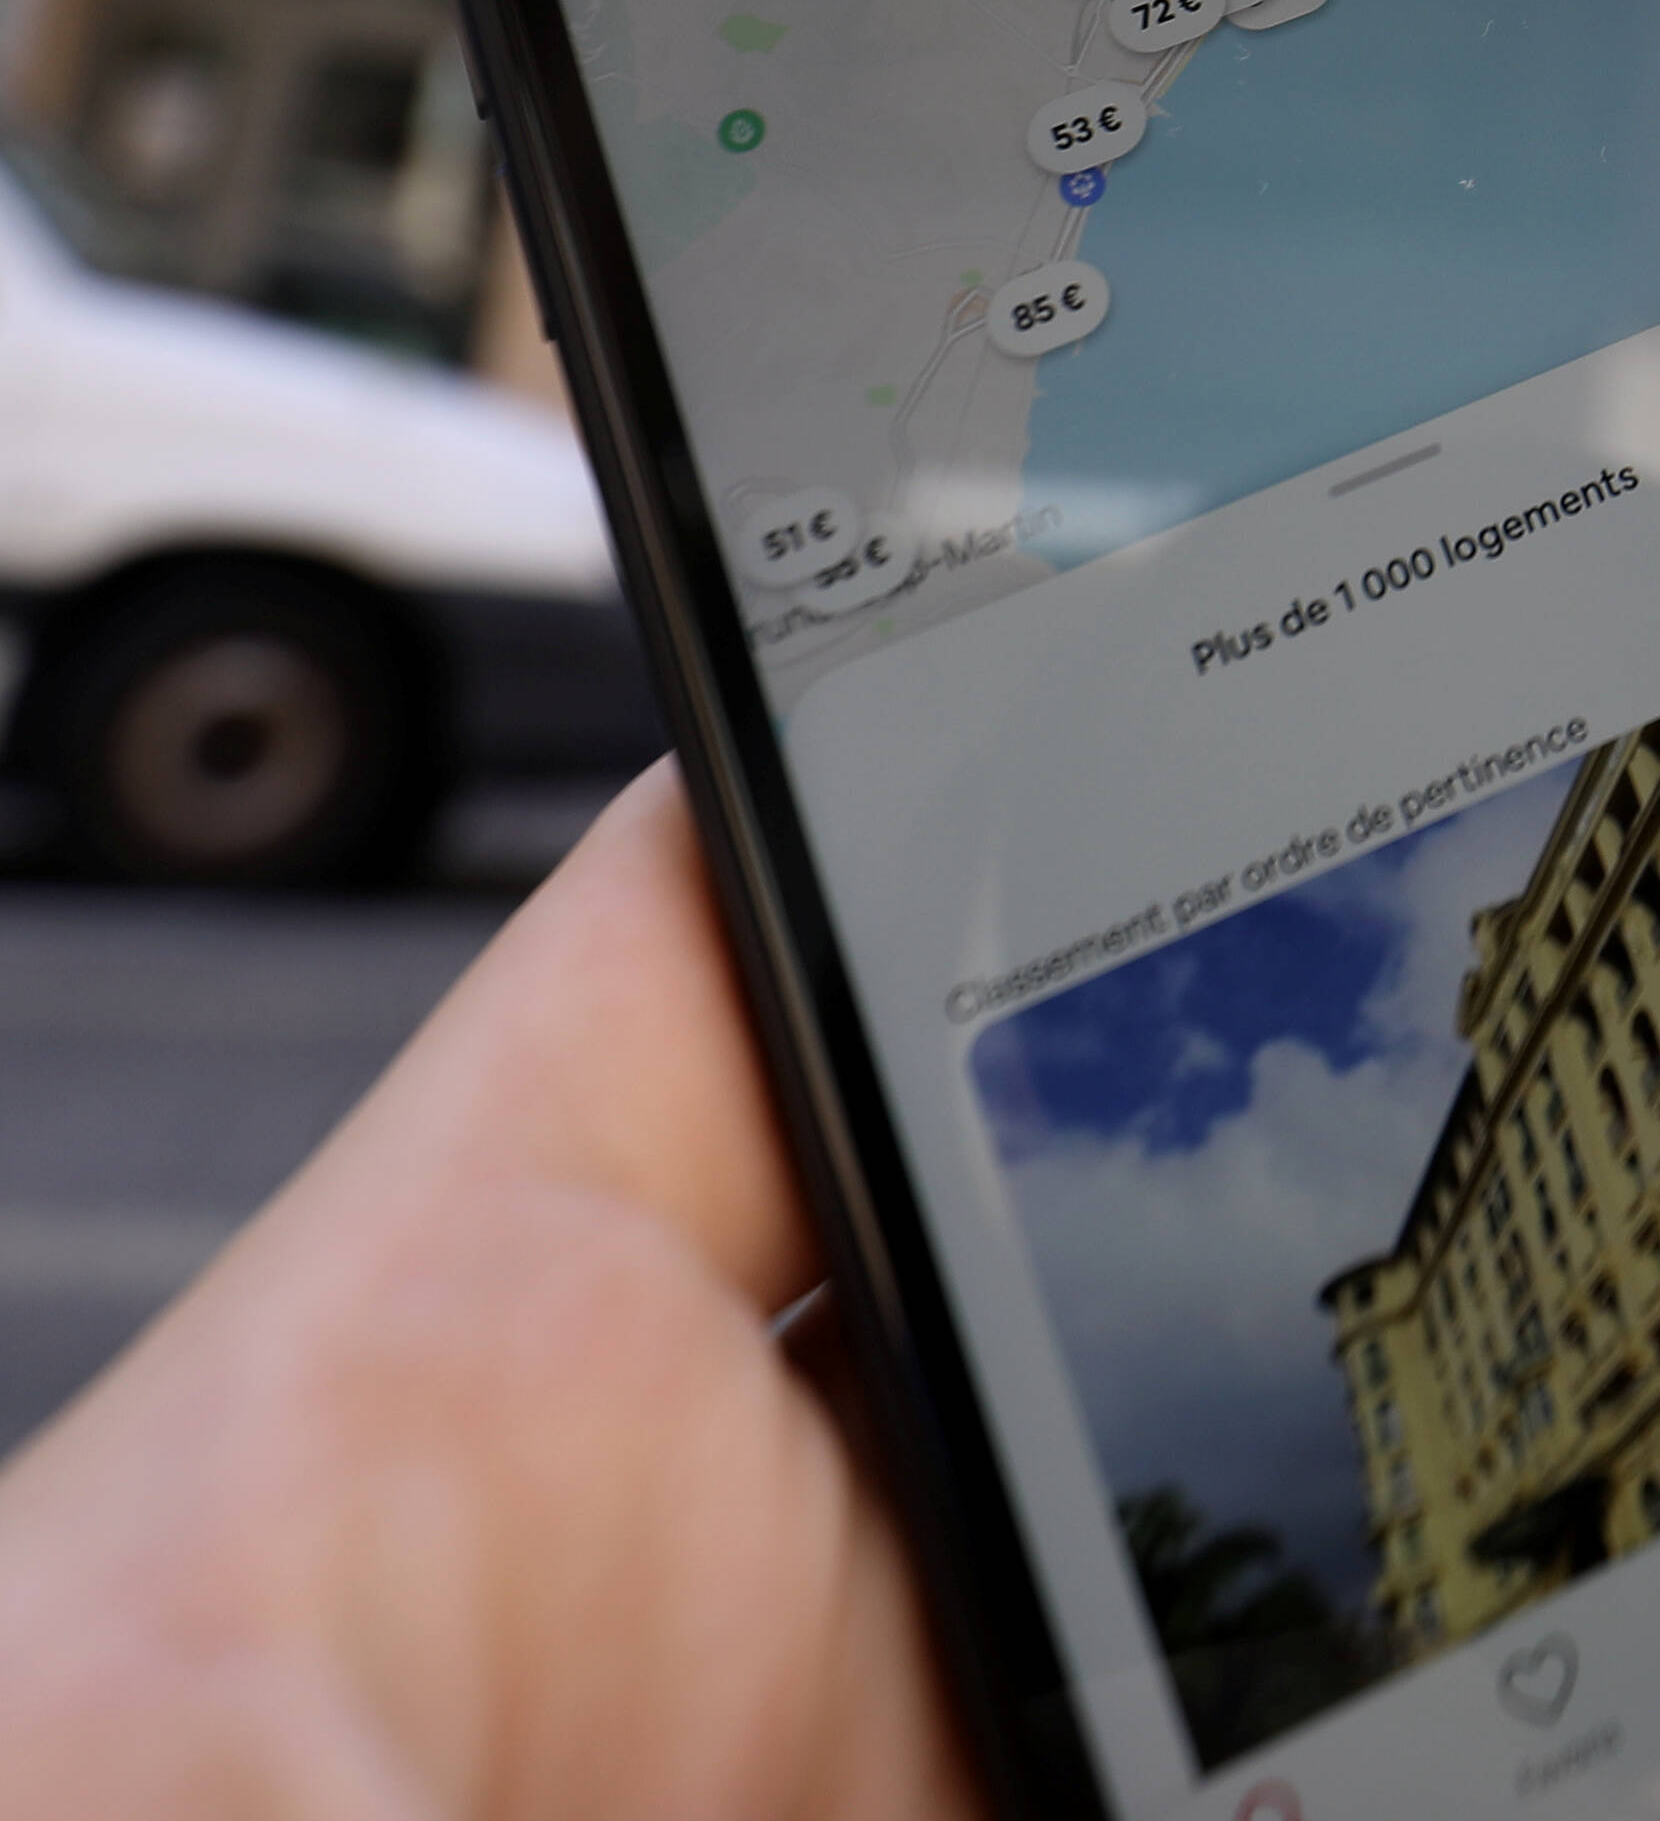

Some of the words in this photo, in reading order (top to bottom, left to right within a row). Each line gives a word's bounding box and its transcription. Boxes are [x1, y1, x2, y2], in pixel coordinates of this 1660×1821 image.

[1190, 620, 1274, 676] Plus
[1279, 596, 1331, 638] de
[1439, 464, 1640, 568] logements
[1172, 872, 1234, 927] par
[1240, 827, 1343, 892] ordre
[1346, 802, 1395, 844] de
[1398, 715, 1591, 831] pertinence
